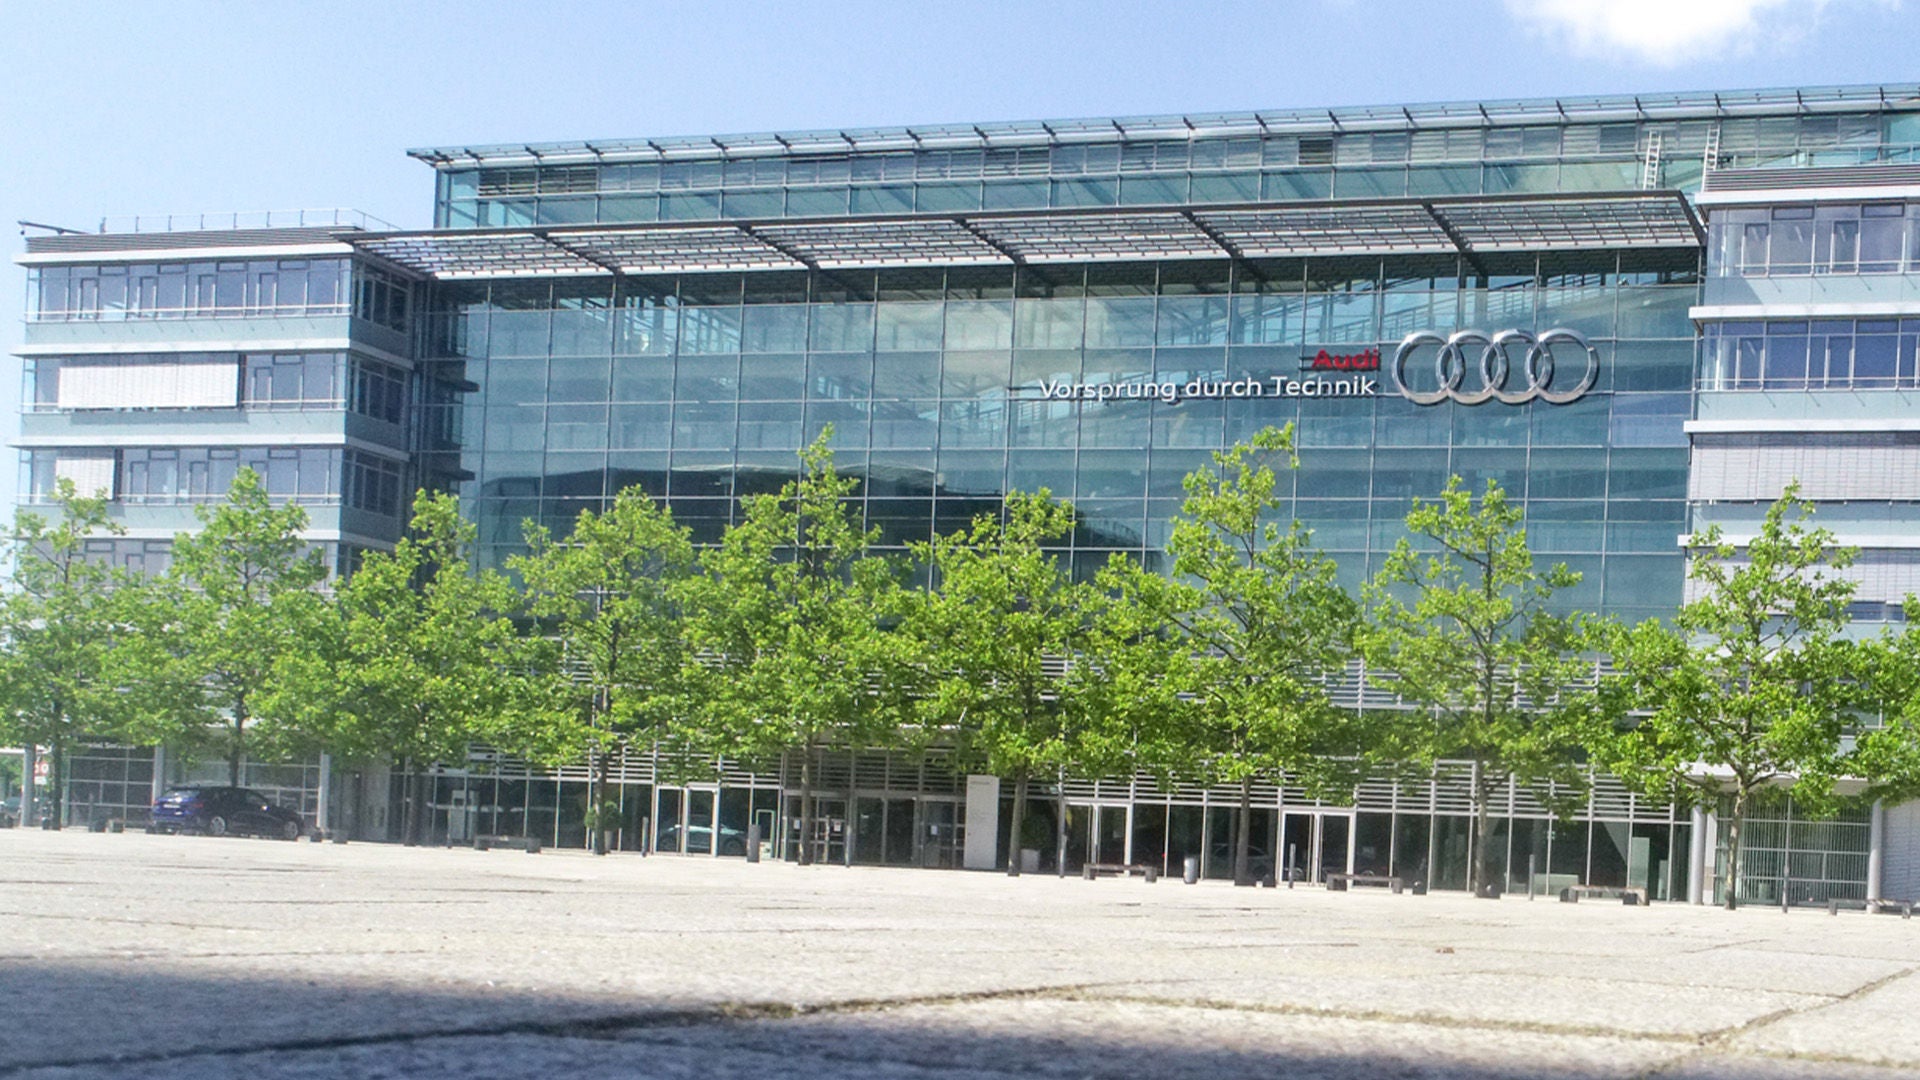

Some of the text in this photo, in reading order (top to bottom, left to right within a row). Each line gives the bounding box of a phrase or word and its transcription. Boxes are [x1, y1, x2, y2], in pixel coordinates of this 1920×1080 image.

[1311, 349, 1379, 369] Audi
[1039, 376, 1376, 402] Vorsprung durch Technik
